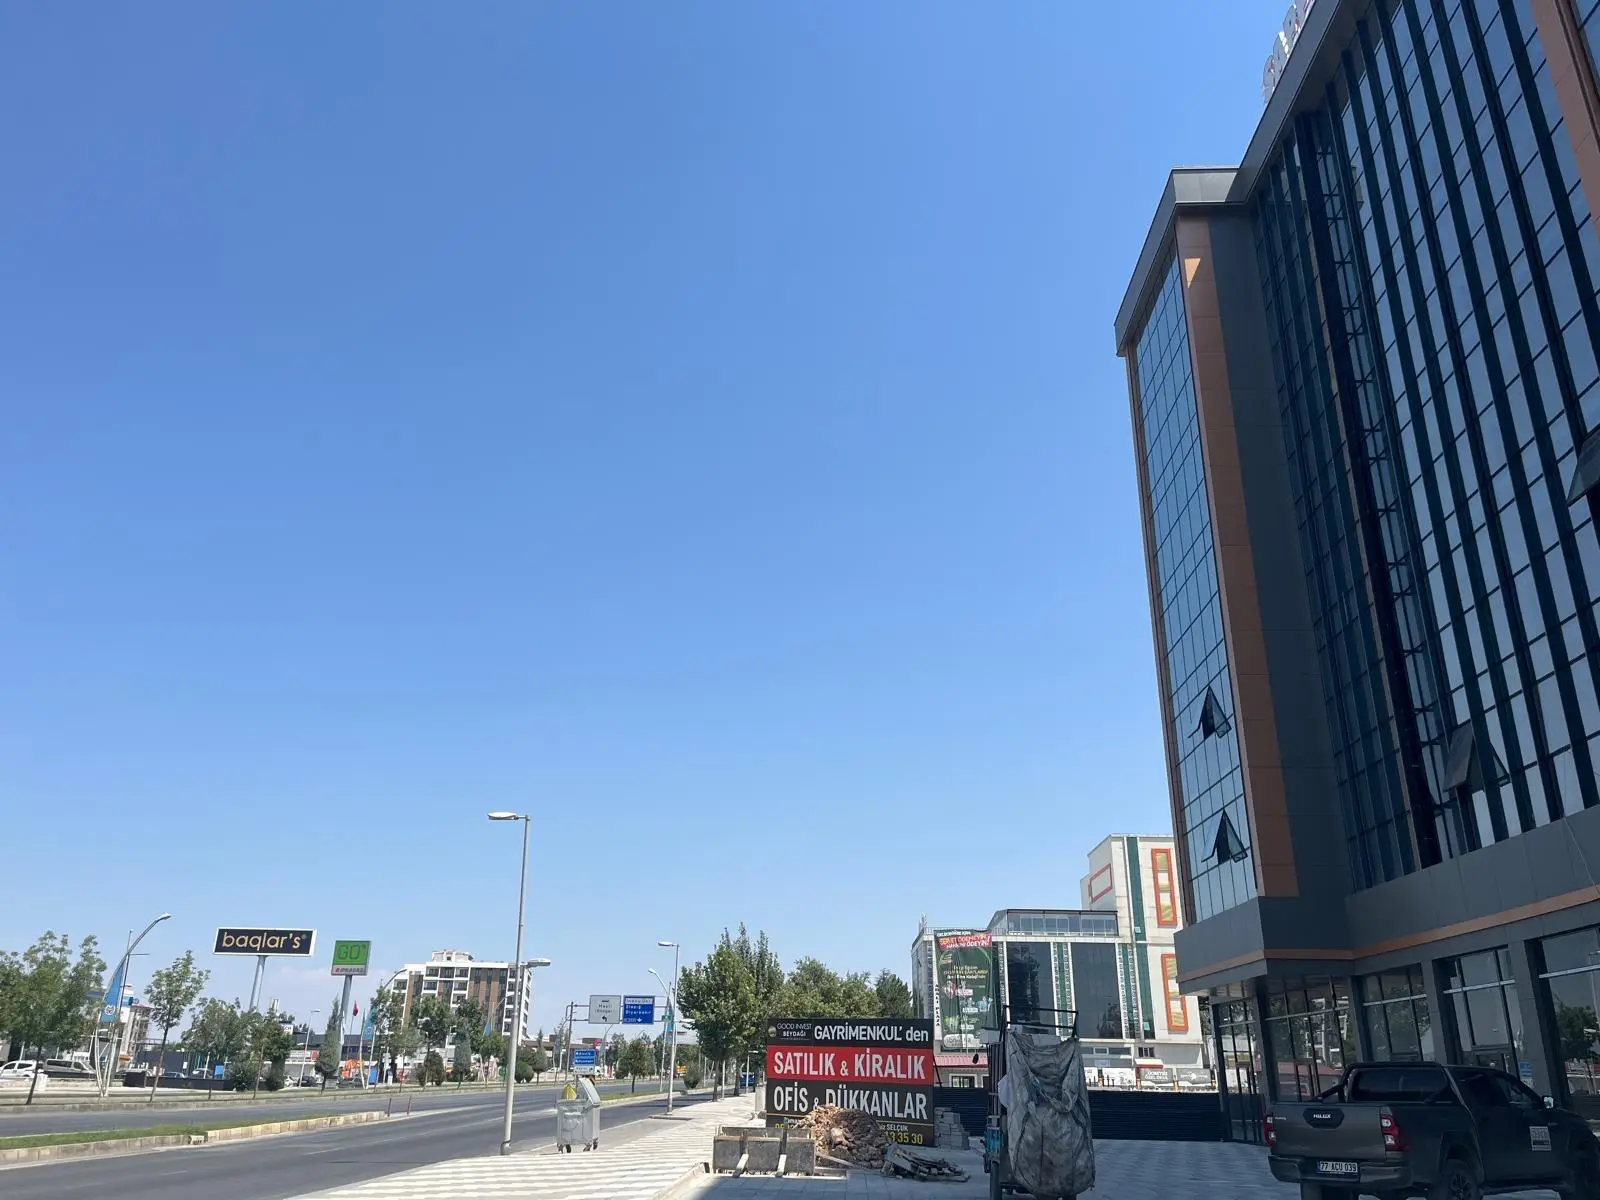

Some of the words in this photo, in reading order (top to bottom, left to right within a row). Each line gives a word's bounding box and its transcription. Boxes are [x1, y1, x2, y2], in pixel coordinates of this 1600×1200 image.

[222, 932, 300, 951] baqlar's
[777, 1022, 795, 1030] GOOD
[905, 1026, 929, 1042] den
[774, 1052, 836, 1076] SATILIK
[840, 1060, 849, 1077] &
[854, 1048, 926, 1080] KİRALIK
[773, 1081, 808, 1113] OFİS
[825, 1084, 928, 1120] DÜKKANLAR
[898, 1132, 909, 1143] 35
[911, 1133, 923, 1144] 30
